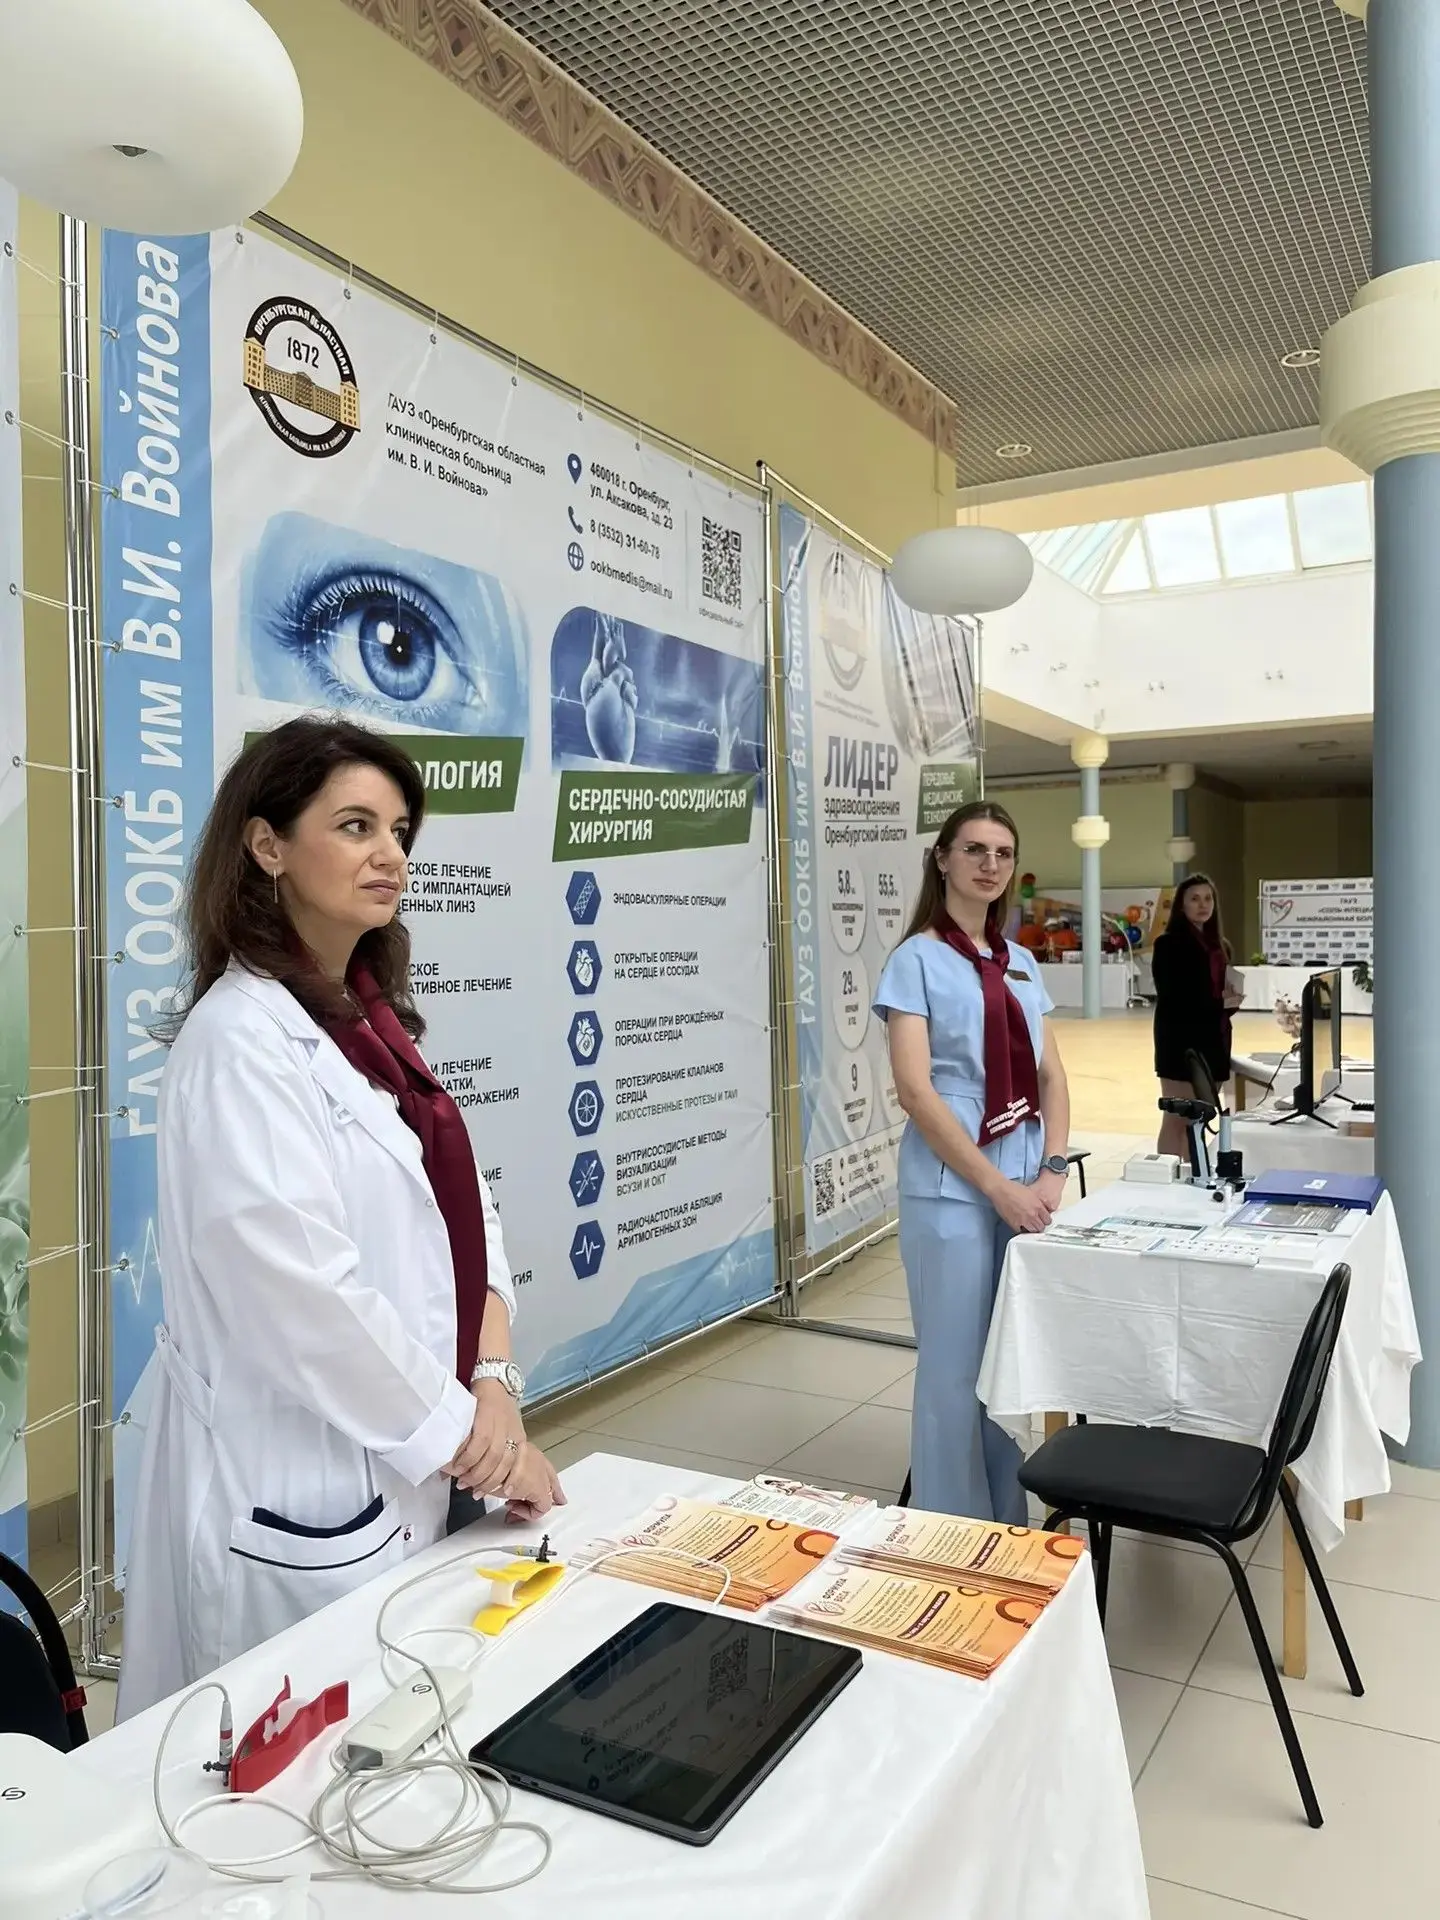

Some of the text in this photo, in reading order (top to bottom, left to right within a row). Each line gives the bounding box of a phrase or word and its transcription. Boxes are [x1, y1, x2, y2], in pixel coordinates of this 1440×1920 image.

[287, 336, 319, 369] 1872
[119, 240, 181, 517] Войнова
[387, 393, 546, 476] ГАУЗ «Оренбургская областная
[386, 422, 511, 484] клиническая больница
[388, 448, 488, 497] им. В. И. Войнова»
[590, 462, 620, 488] 460018
[629, 481, 671, 513] Оренбург,
[590, 484, 603, 499] ул.
[606, 489, 650, 520] Аксакова,
[663, 515, 673, 530] 23
[590, 519, 596, 533] 8
[598, 522, 624, 549] (3532)
[590, 560, 673, 600] ookbmedis@mail.ru
[122, 541, 182, 661] В.И.
[140, 679, 183, 768] им
[413, 760, 503, 790] ЛОГИЯ
[823, 735, 899, 798] ЛИДЕР
[568, 788, 747, 815] СЕРДЕЧНО-СОСУДИСТАЯ
[824, 797, 900, 819] здравоохранения
[568, 818, 653, 844] ХИРУРГИЯ
[825, 824, 907, 848] Оренбургской области
[124, 788, 184, 966] ООКБ
[407, 862, 492, 879] СКОЕ ЛЕЧЕНИЕ
[411, 881, 419, 893] С
[422, 881, 512, 898] ИМПЛАНТАЦИЕЙ
[794, 837, 812, 933] ООКБ
[400, 898, 476, 913] ЕННЫХ ЛИНЗ
[613, 892, 726, 907] ЭНДОВАСКУЛЯРНЫЕ ОПЕРАЦИИ
[409, 963, 440, 977] СКОЕ
[614, 951, 698, 964] ОТКРЫТЫЕ ОПЕРАЦИИ
[409, 977, 512, 995] АТИВНОЕ ЛЕЧЕНИЕ
[614, 965, 699, 979] НА СЕРДЦЕ И СОСУДАХ
[799, 943, 817, 1025] ГАУЗ
[842, 970, 853, 995] 29
[615, 1010, 724, 1032] ОПЕРАЦИИ ПРИ ВРОЖДЁННЫХ
[615, 1029, 683, 1047] ПОРОКАХ СЕРДЦА
[441, 1057, 492, 1075] ЛЕЧЕНИЕ
[616, 1062, 724, 1090] ПРОТЕЗИРОВАНИЕ КЛАПАНОВ
[851, 1063, 858, 1092] 9
[442, 1077, 476, 1092] АТКИ,
[616, 1090, 648, 1105] СЕРДЦА
[616, 1098, 682, 1123] ИСКУССТВЕННЫЕ
[684, 1092, 717, 1107] ПРОТЕЗЫ
[717, 1091, 723, 1101] И
[616, 1129, 728, 1166] ВНУТРИСОСУДИСТЫЕ МЕТОДЫ
[616, 1156, 677, 1181] ВИЗУАЛИЗАЦИИ
[616, 1173, 666, 1197] ВСУЗИ И ОКТ
[617, 1192, 723, 1235] РАДИОЧАСТОТНАЯ АБЛЯЦИЯ
[617, 1215, 698, 1251] АРИТМОГЕННЫХ ЗОН
